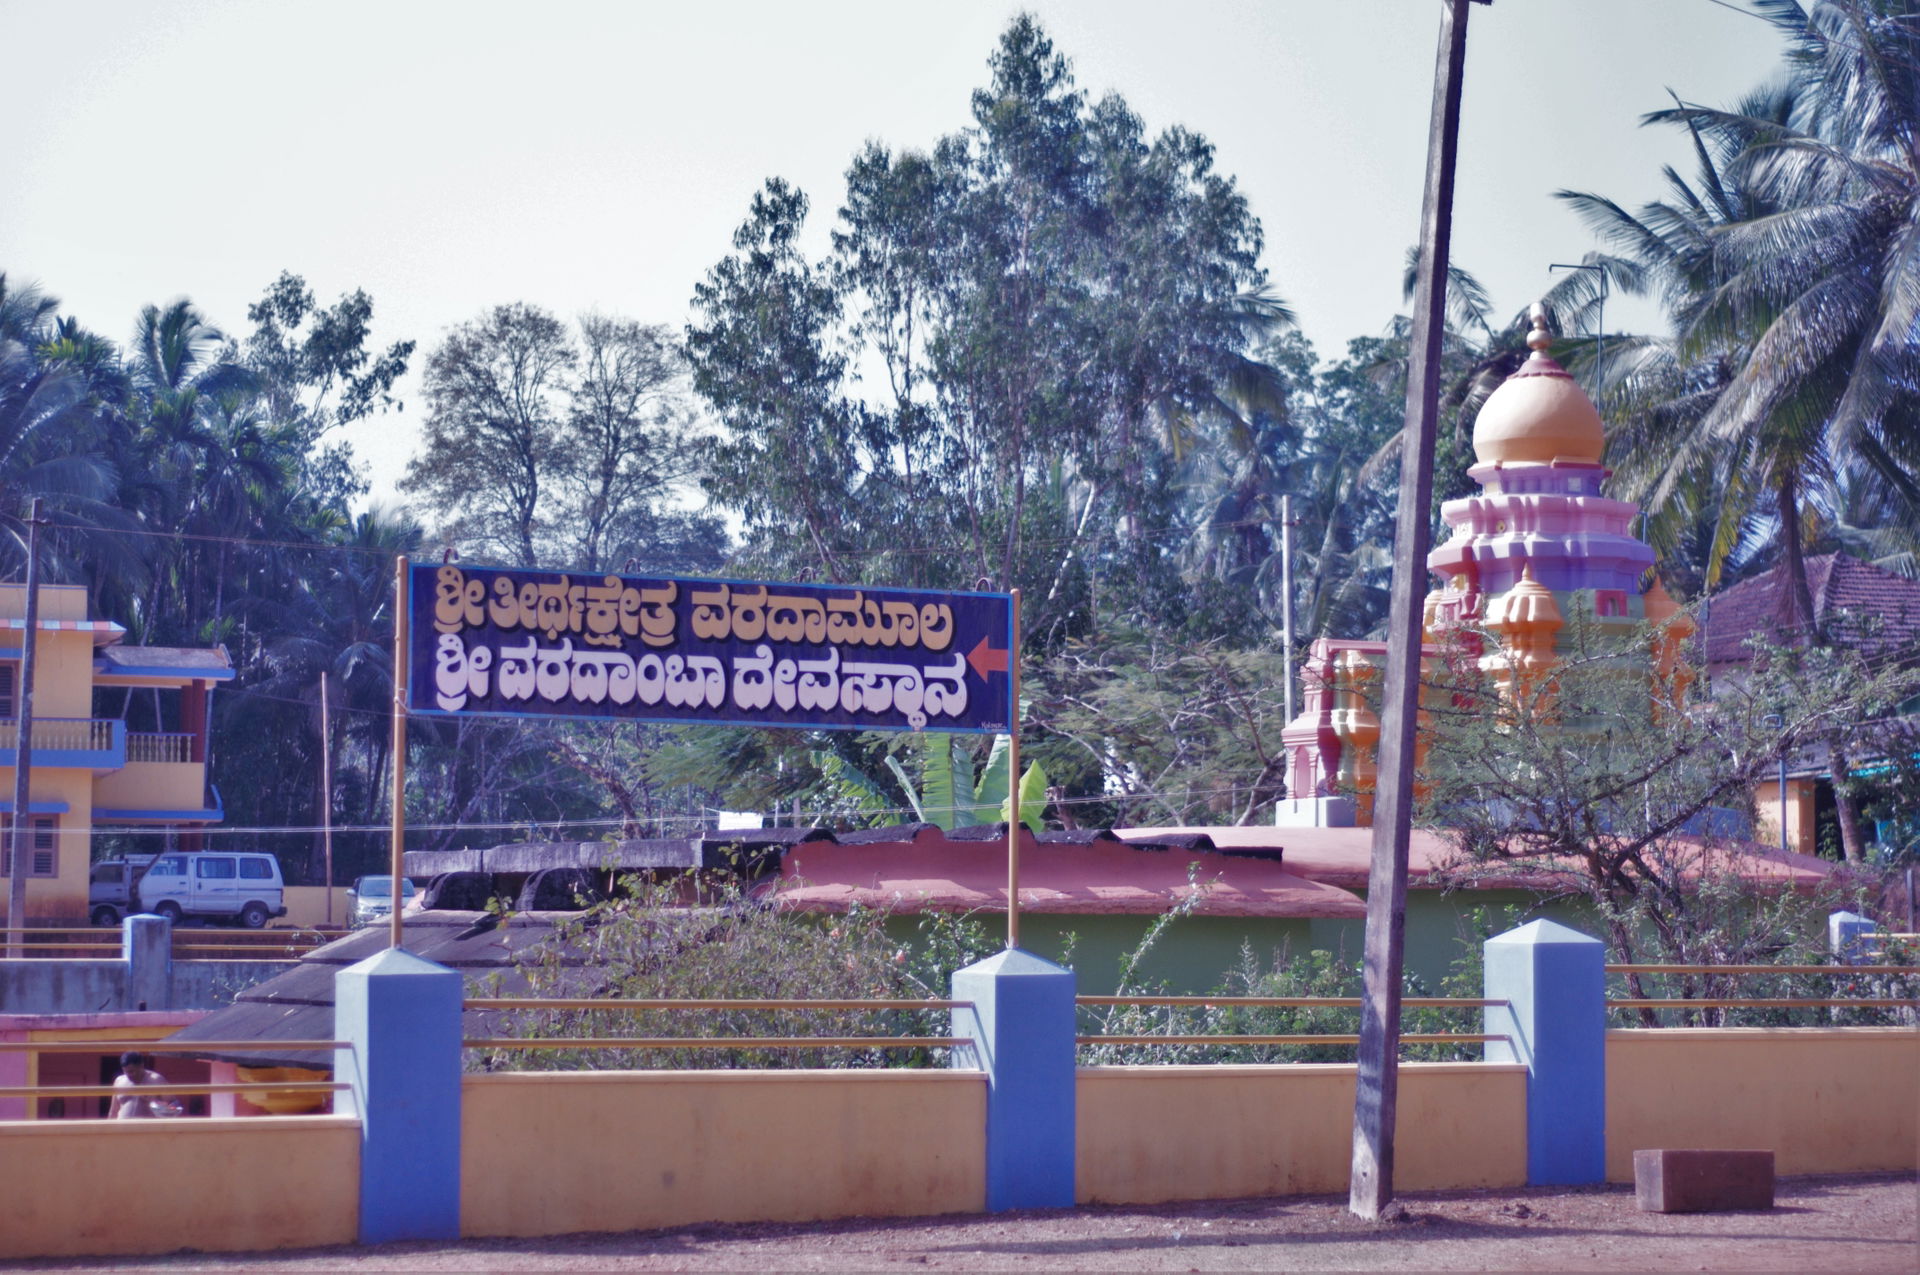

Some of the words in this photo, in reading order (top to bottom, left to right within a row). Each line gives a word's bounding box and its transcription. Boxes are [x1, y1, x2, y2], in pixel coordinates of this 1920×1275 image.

[434, 565, 486, 634] ಶ್ರೀ
[489, 574, 677, 647] ತೀರ್ಥಕ್ಷೇತ್ರ
[691, 583, 953, 650] ವರದಾಮೂಲ
[435, 633, 492, 712] ಶ್ರೀ
[499, 636, 726, 709] ವರದಾಂಬಾ
[733, 644, 968, 732] ದೇವಸ್ಥಾನ
